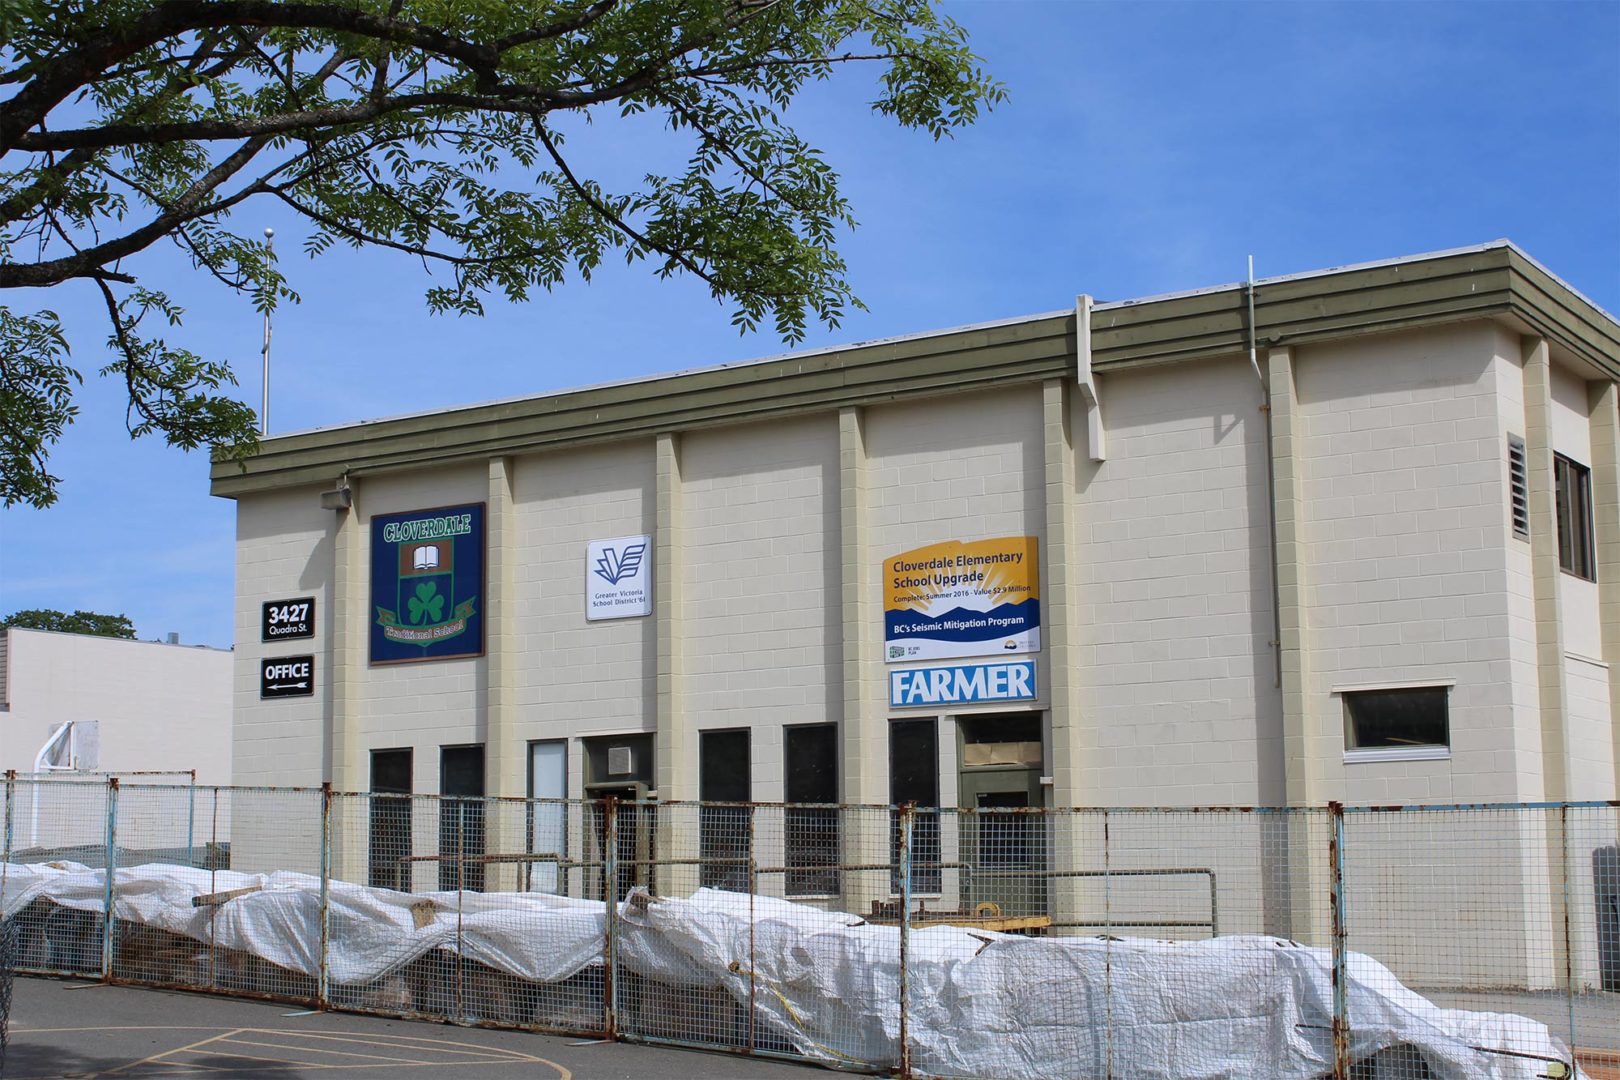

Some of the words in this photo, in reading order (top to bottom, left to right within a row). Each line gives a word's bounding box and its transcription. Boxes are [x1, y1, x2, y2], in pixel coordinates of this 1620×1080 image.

[384, 514, 471, 543] CLOVERDALE
[893, 557, 953, 572] Cloverdale
[956, 552, 1023, 566] Elementary
[893, 575, 931, 589] School
[934, 571, 984, 586] Upgrade
[993, 586, 1008, 594] $2.9
[268, 604, 308, 624] 3427
[269, 624, 298, 635] Quadra
[298, 623, 308, 632] St.
[386, 625, 433, 640] Traditional
[434, 620, 464, 638] School
[894, 624, 910, 634] BC's
[912, 622, 942, 632] Seismic
[944, 618, 987, 630] Mitigation
[988, 617, 1024, 628] Program
[265, 662, 309, 680] OFFICE
[892, 664, 1033, 704] FARMER
